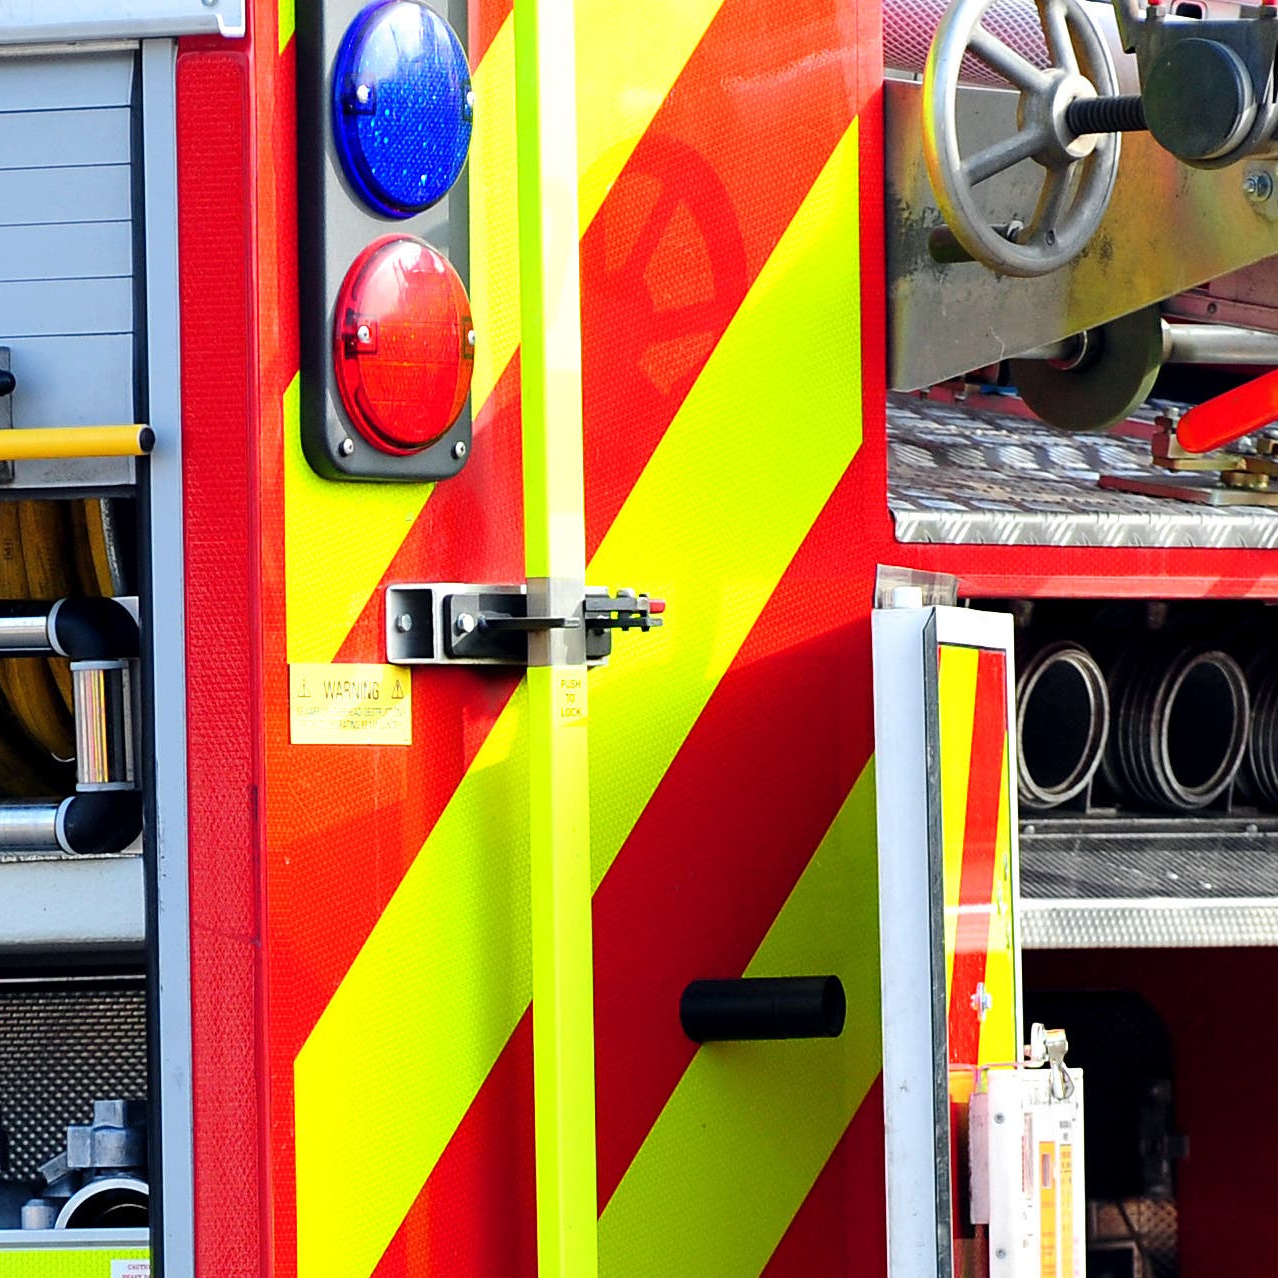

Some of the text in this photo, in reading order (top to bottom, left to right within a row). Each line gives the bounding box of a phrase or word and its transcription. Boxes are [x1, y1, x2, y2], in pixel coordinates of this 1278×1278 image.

[560, 679, 582, 689] PUSH
[323, 681, 380, 700] WARNING
[565, 693, 576, 703] TO
[560, 707, 582, 717] LOCK
